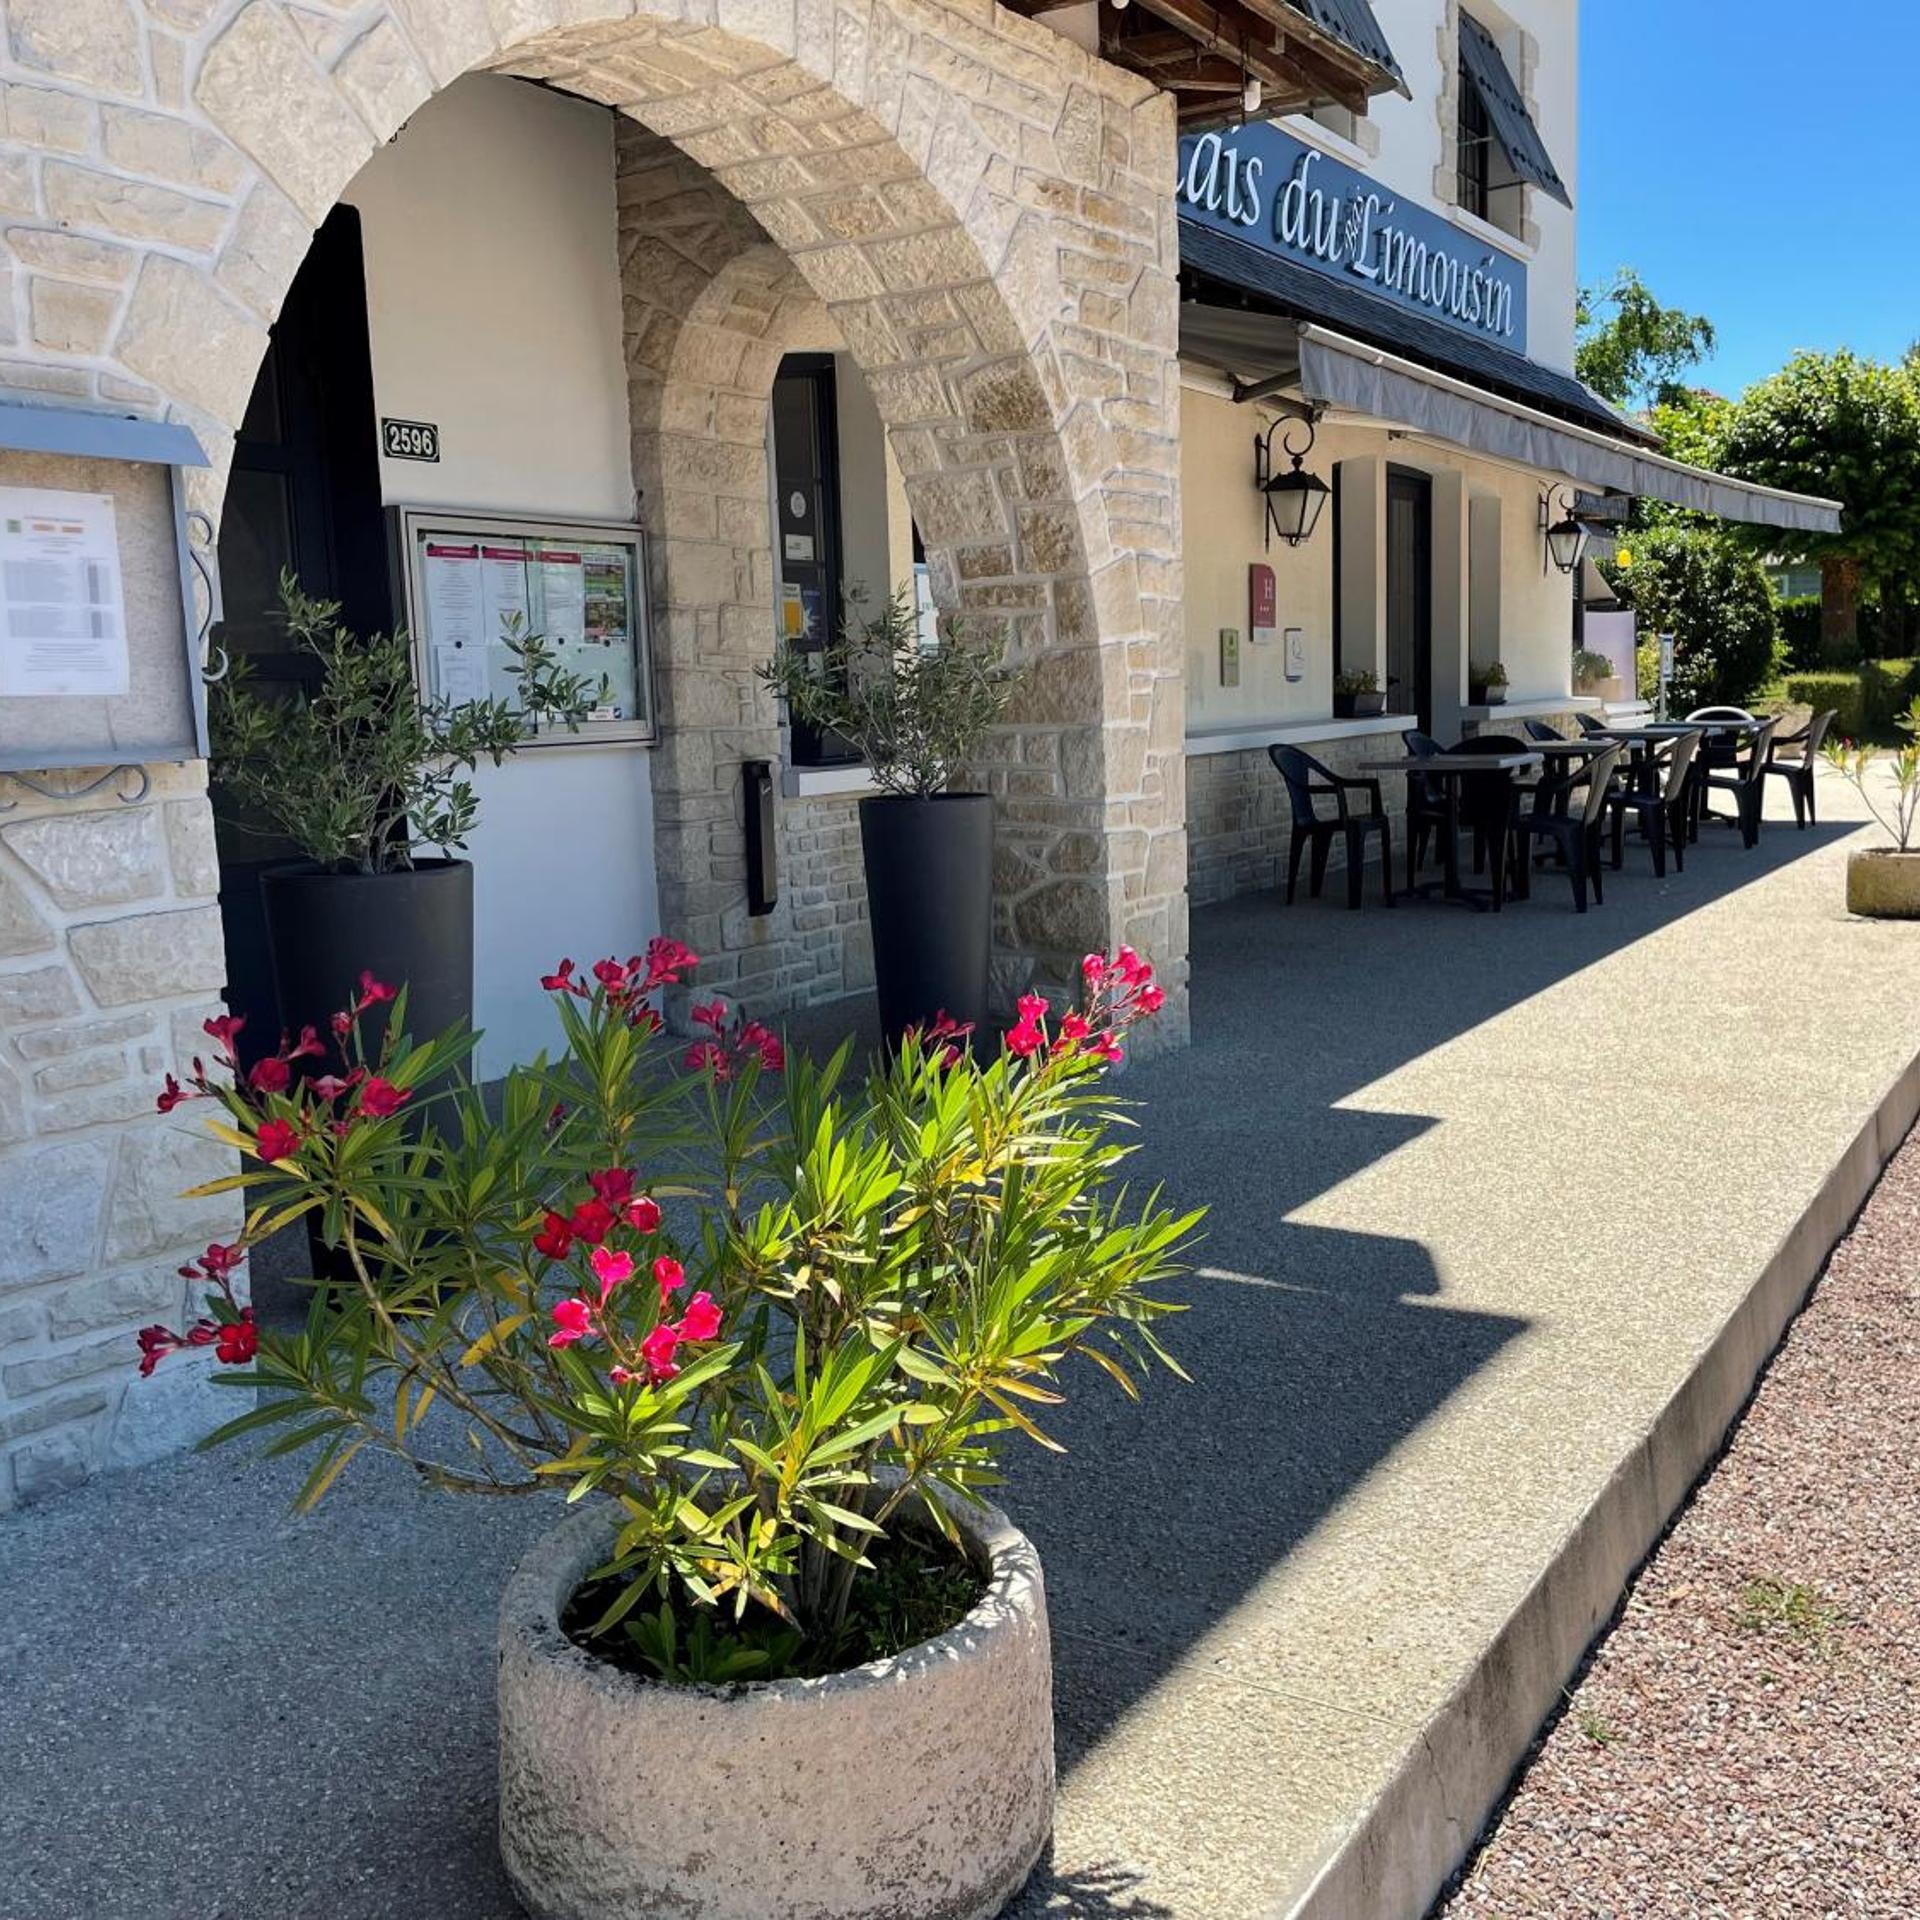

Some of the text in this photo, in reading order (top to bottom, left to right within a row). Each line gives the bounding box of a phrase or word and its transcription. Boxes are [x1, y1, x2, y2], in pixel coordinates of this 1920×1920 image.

[1175, 125, 1515, 337] ais du Limousin
[390, 425, 433, 455] 2596
